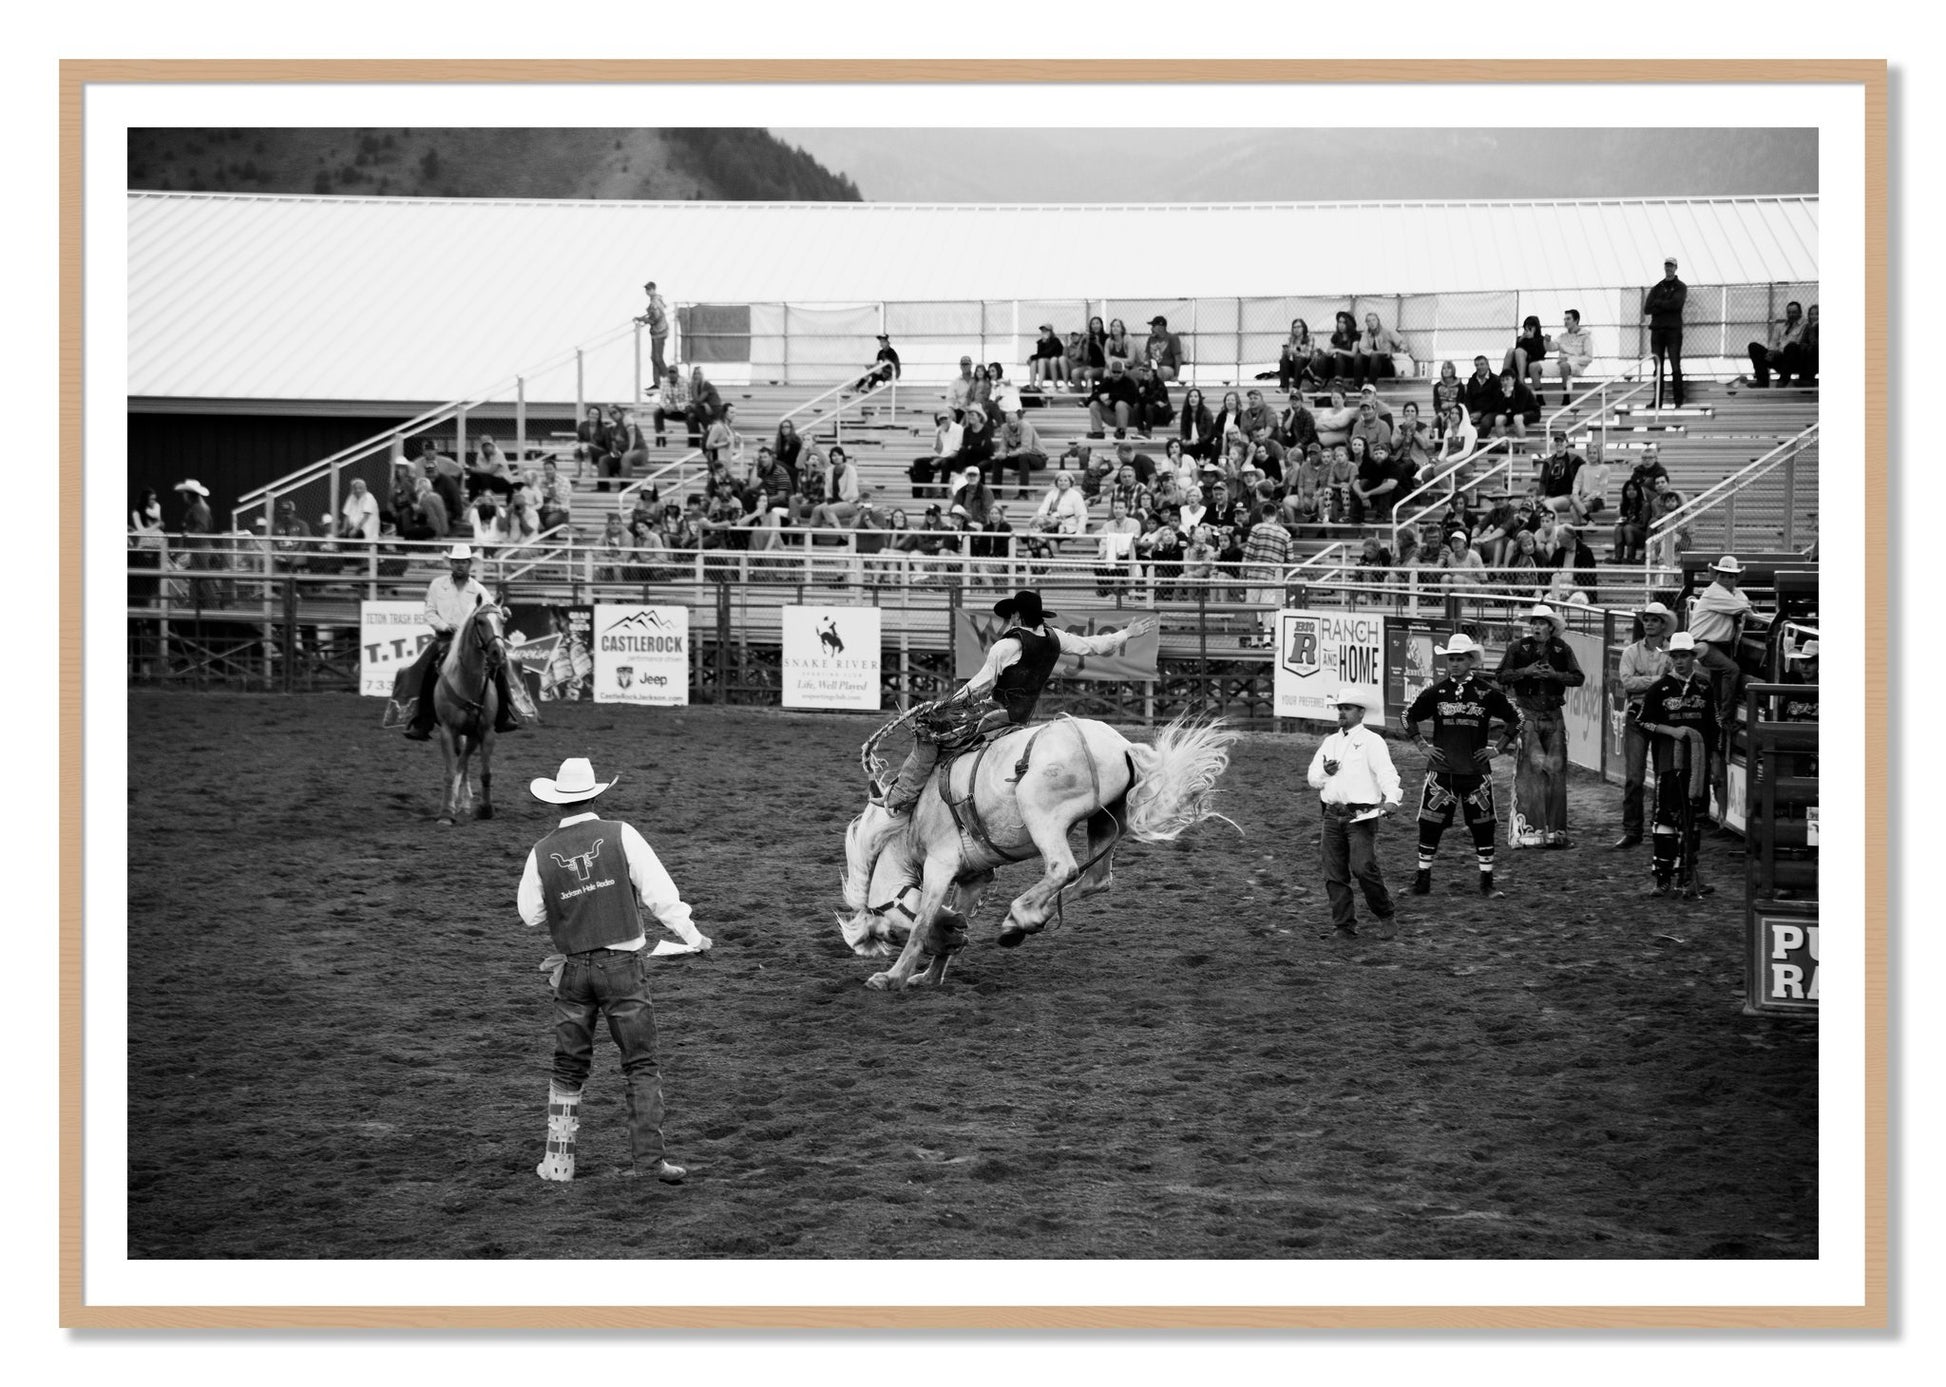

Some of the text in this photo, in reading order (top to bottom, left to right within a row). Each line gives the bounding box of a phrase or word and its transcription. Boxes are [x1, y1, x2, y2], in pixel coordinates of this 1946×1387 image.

[366, 613, 387, 625] TETON
[388, 613, 411, 625] TRASH
[1294, 621, 1316, 633] BIG
[1321, 617, 1379, 645] RANCH
[601, 635, 683, 653] CASTLEROCK
[1287, 632, 1318, 666] R
[784, 658, 878, 670] SNAKE RIVER
[1322, 652, 1337, 667] AND
[1339, 644, 1380, 685] HOME
[640, 672, 668, 688] Jeep
[819, 680, 838, 690] Well
[839, 681, 868, 692] Played
[560, 879, 615, 900] Jackson Hole Rodeo
